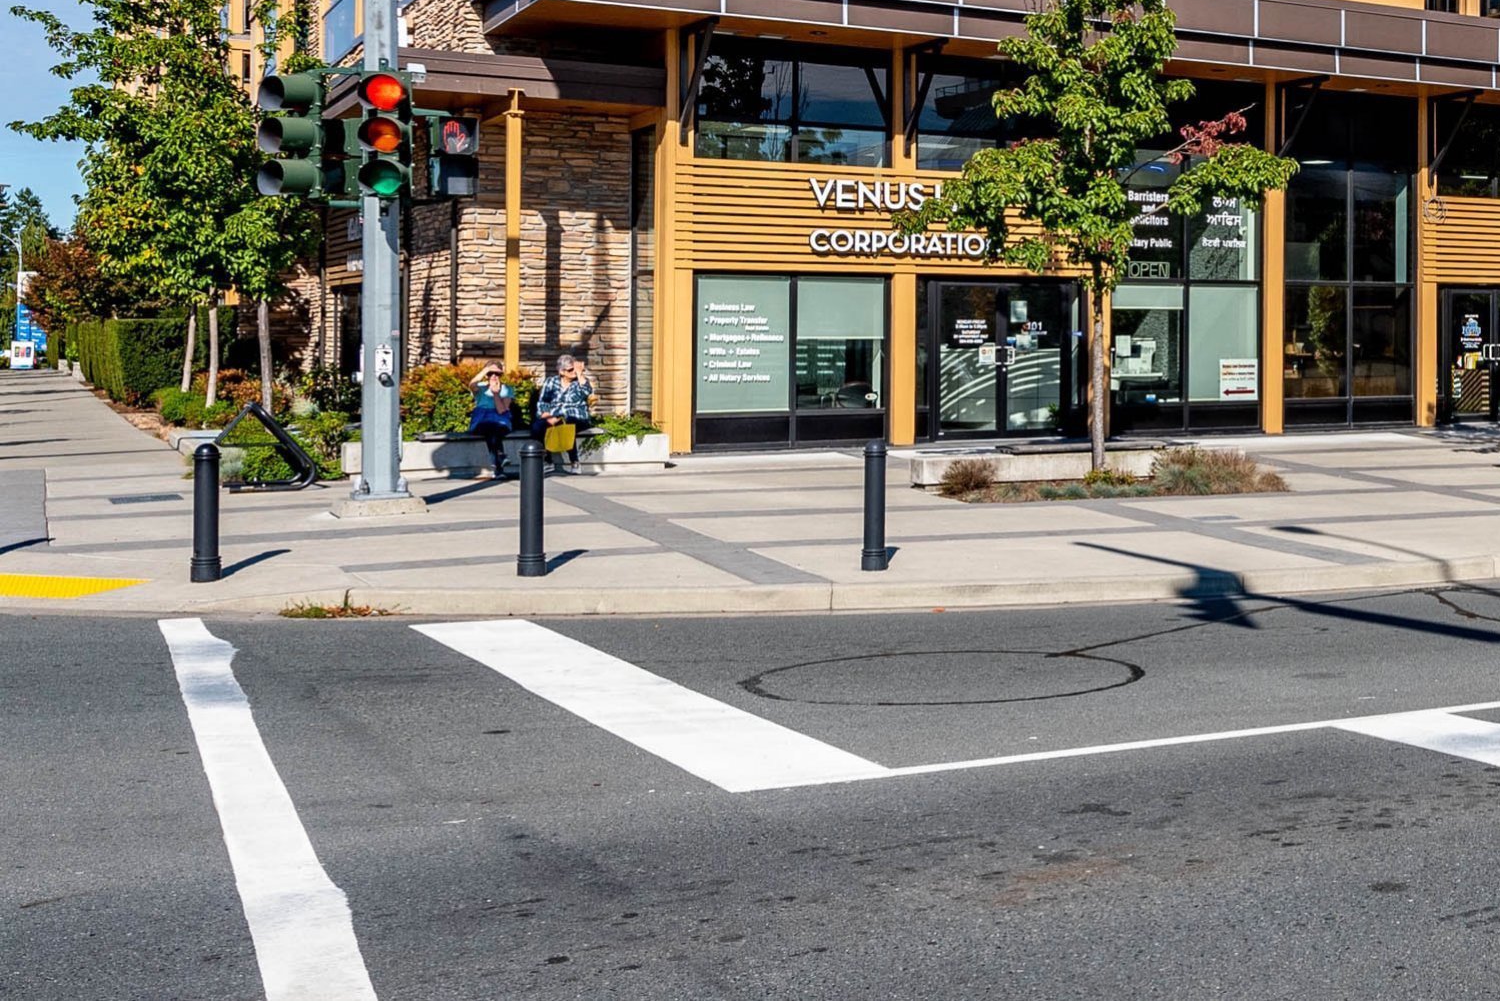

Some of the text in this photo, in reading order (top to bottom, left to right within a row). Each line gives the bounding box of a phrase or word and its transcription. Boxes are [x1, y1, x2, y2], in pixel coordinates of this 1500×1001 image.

[809, 178, 925, 211] VENUS
[1128, 190, 1169, 202] Barristers
[1142, 203, 1156, 213] and
[1150, 238, 1173, 248] Public
[1130, 262, 1168, 278] OPEN
[709, 303, 756, 312] Business Law
[709, 316, 768, 326] Property Transfer
[709, 347, 726, 355] Wills
[736, 347, 761, 355] Estates
[708, 360, 753, 369] Criminal Law
[708, 373, 771, 384] All Notary Services
